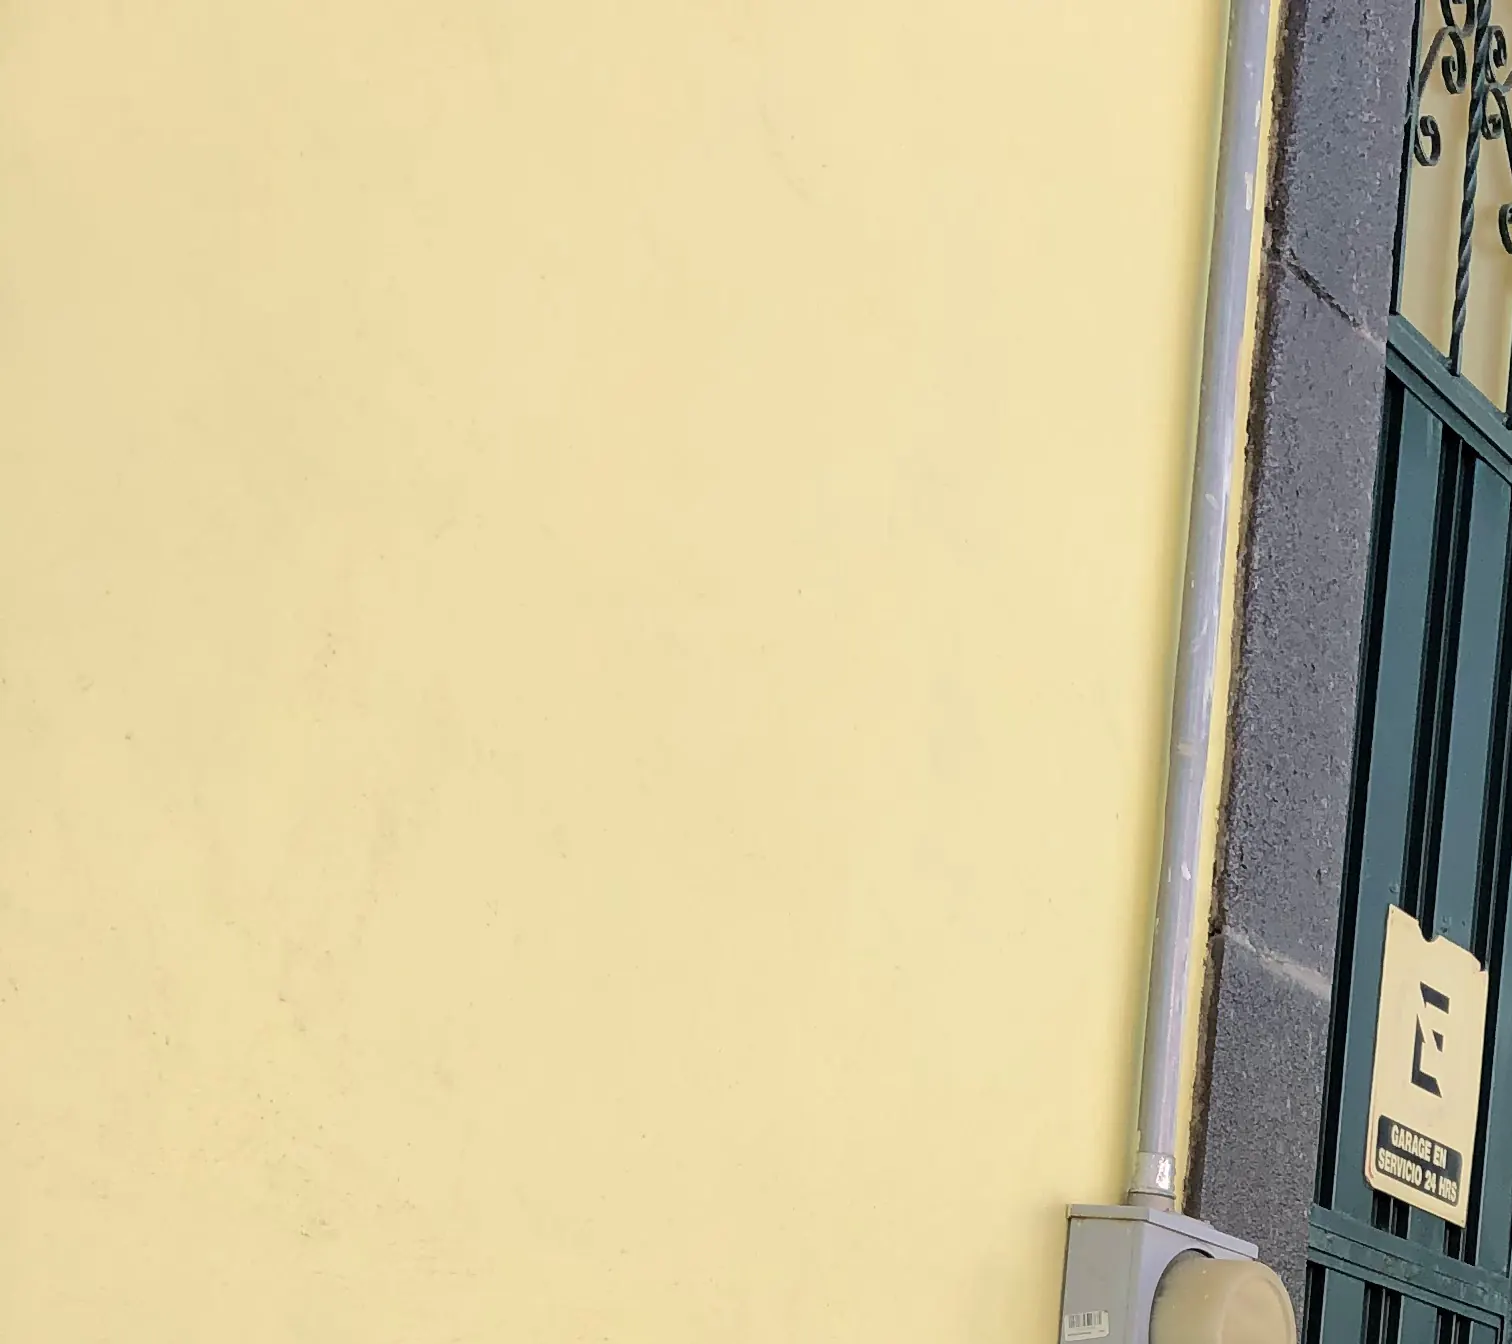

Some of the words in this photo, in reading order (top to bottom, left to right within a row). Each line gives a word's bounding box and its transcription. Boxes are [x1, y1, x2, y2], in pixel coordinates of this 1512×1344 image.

[1391, 1124, 1432, 1162] GARAGE
[1432, 1143, 1448, 1169] EN
[1378, 1147, 1423, 1186] SERVICIO
[1424, 1169, 1437, 1193] 24
[1438, 1175, 1458, 1203] HRS
